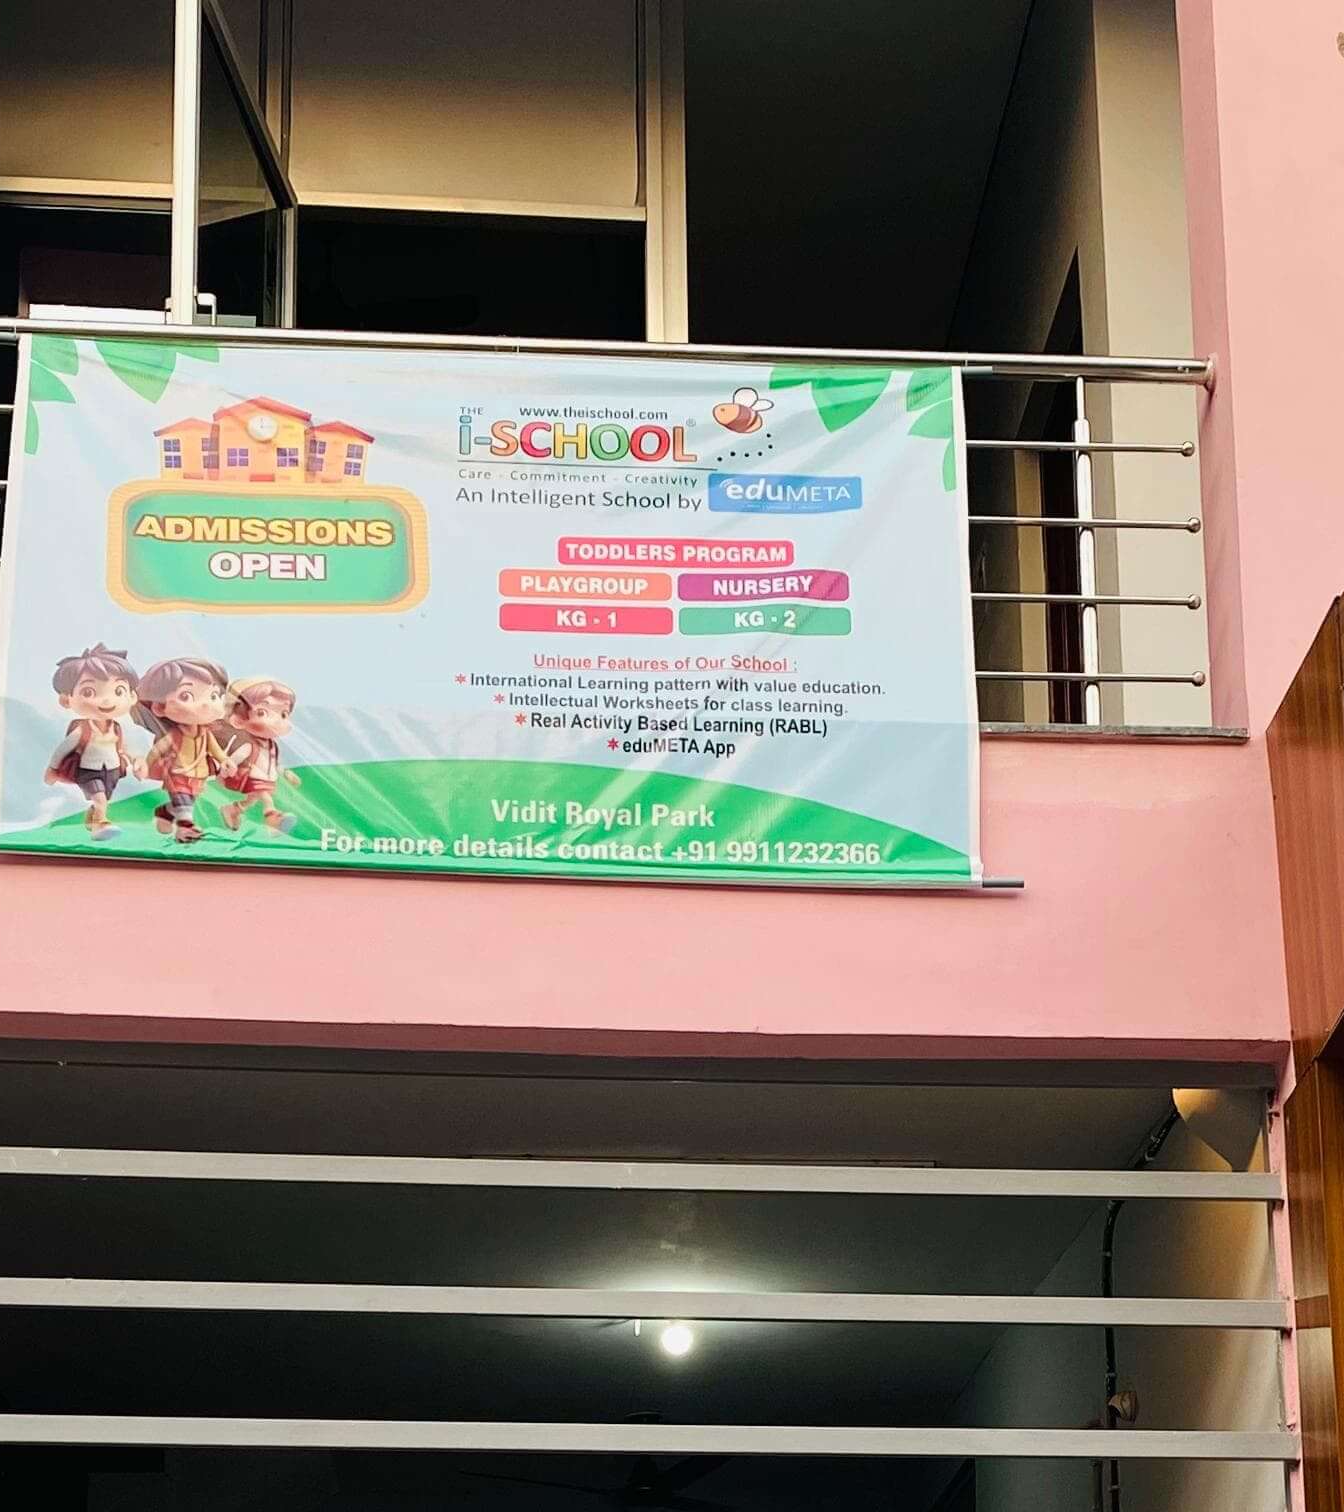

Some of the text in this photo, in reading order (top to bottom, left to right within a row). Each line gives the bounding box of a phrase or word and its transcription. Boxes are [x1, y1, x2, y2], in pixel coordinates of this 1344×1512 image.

[460, 407, 482, 415] THE
[520, 406, 667, 420] www.theischool.com
[458, 414, 698, 462] i-SCHOOL
[459, 469, 491, 479] Care
[511, 471, 605, 482] Commitment
[625, 475, 697, 488] Creativity
[456, 488, 701, 511] An Intelligent School by
[726, 478, 851, 501] eduMETA
[135, 516, 394, 546] ADMISSIONS
[567, 544, 786, 562] TODDLERS PROGRAM
[208, 551, 327, 581] OPEN
[521, 575, 647, 594] PLAYGROUP
[713, 576, 812, 596] NURSERY
[557, 610, 586, 626] KG
[608, 612, 616, 627] 1
[735, 611, 764, 627] KG
[784, 609, 795, 627] 2
[534, 654, 592, 671] Unique
[597, 656, 670, 672] Features
[674, 657, 690, 670] of
[696, 657, 725, 671] Our
[732, 655, 787, 672] School
[471, 673, 885, 694] International Learning pattern with value education.
[510, 693, 849, 716] Intellectual Worksheets for class learning.
[532, 713, 827, 738] Real Activity Based Learning (RABL)
[623, 738, 735, 758] eduMETA App
[490, 799, 715, 830] Vidit Royal Park
[320, 830, 879, 865] For more details contact +91 9911232366
